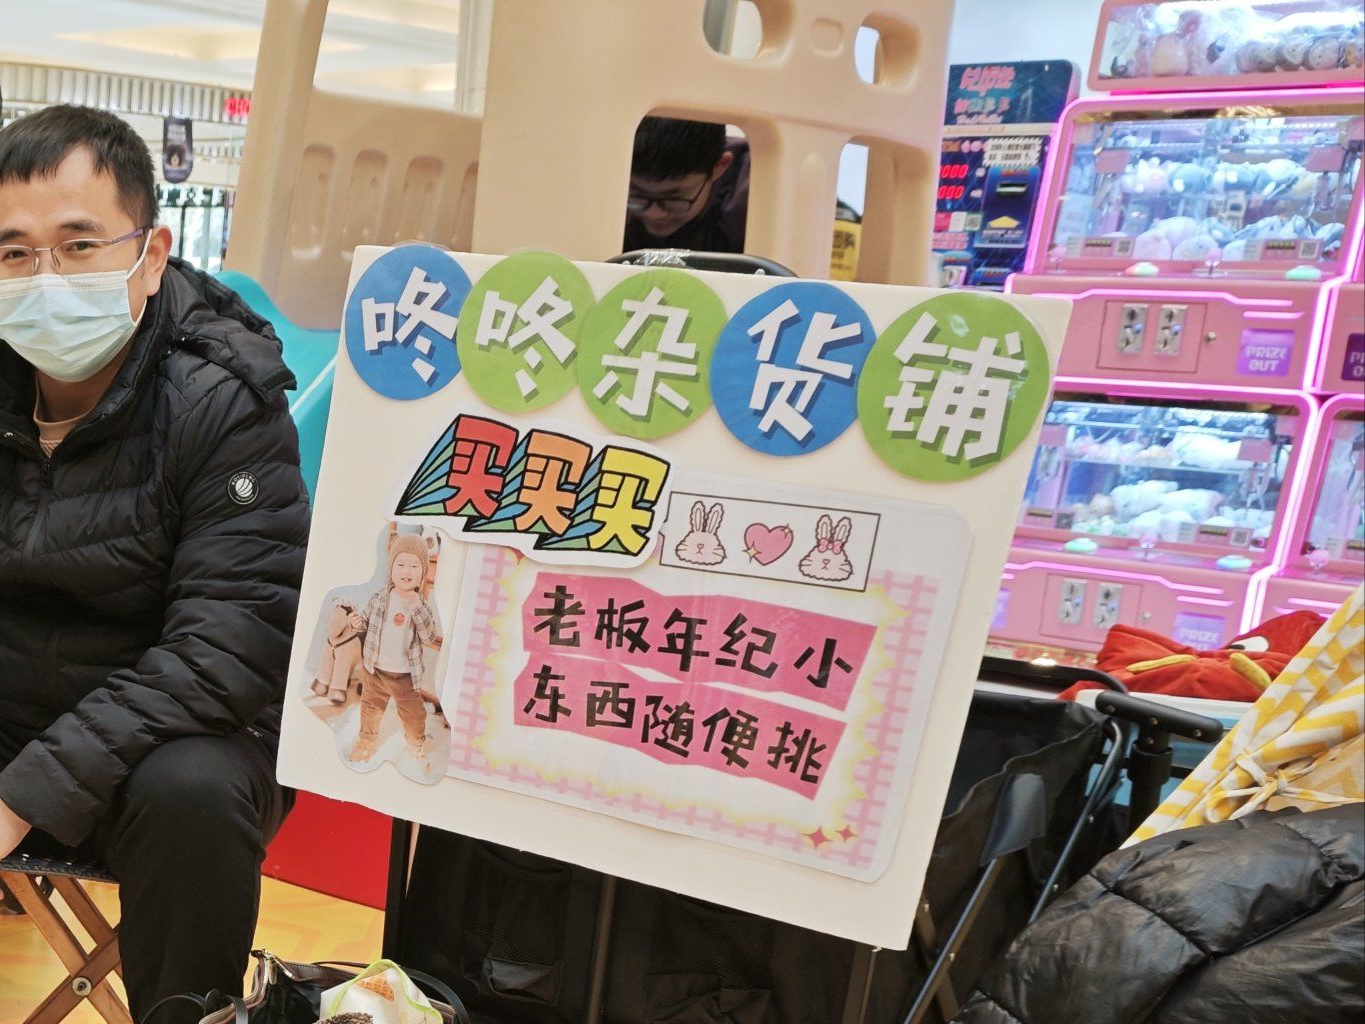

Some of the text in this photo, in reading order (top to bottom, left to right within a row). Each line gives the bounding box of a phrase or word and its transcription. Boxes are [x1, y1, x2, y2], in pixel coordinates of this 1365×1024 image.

[361, 266, 1025, 464] 咚咚杂货铺
[1245, 346, 1287, 360] PRIZE
[1249, 359, 1279, 372] OUT
[442, 418, 668, 556] 买买买
[531, 584, 854, 680] 老板年纪小
[521, 664, 828, 785] 东西随便挑
